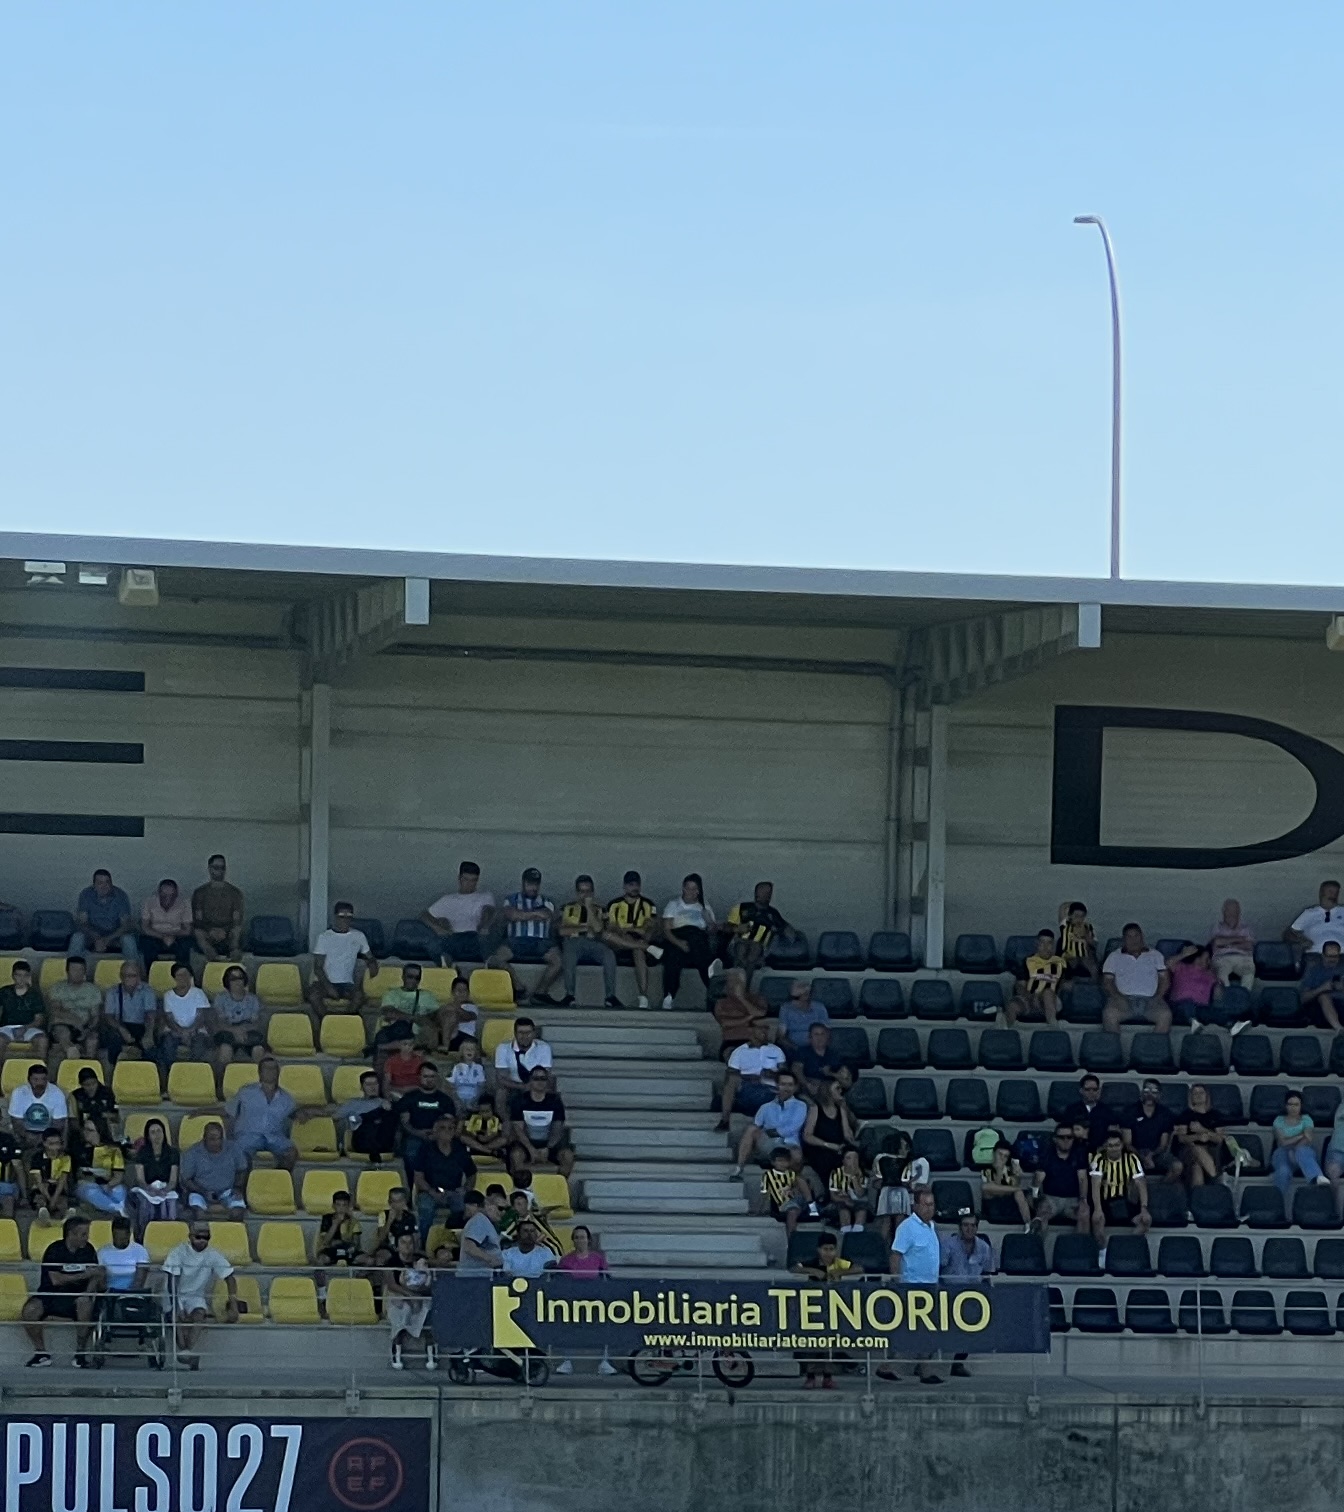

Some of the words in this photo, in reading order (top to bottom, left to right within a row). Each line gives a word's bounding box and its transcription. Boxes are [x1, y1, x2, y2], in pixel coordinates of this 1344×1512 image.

[537, 1290, 760, 1326] Inmobiliaria
[768, 1288, 991, 1332] TENORIO
[643, 1331, 889, 1349] www.inmobiliariatenorio.com
